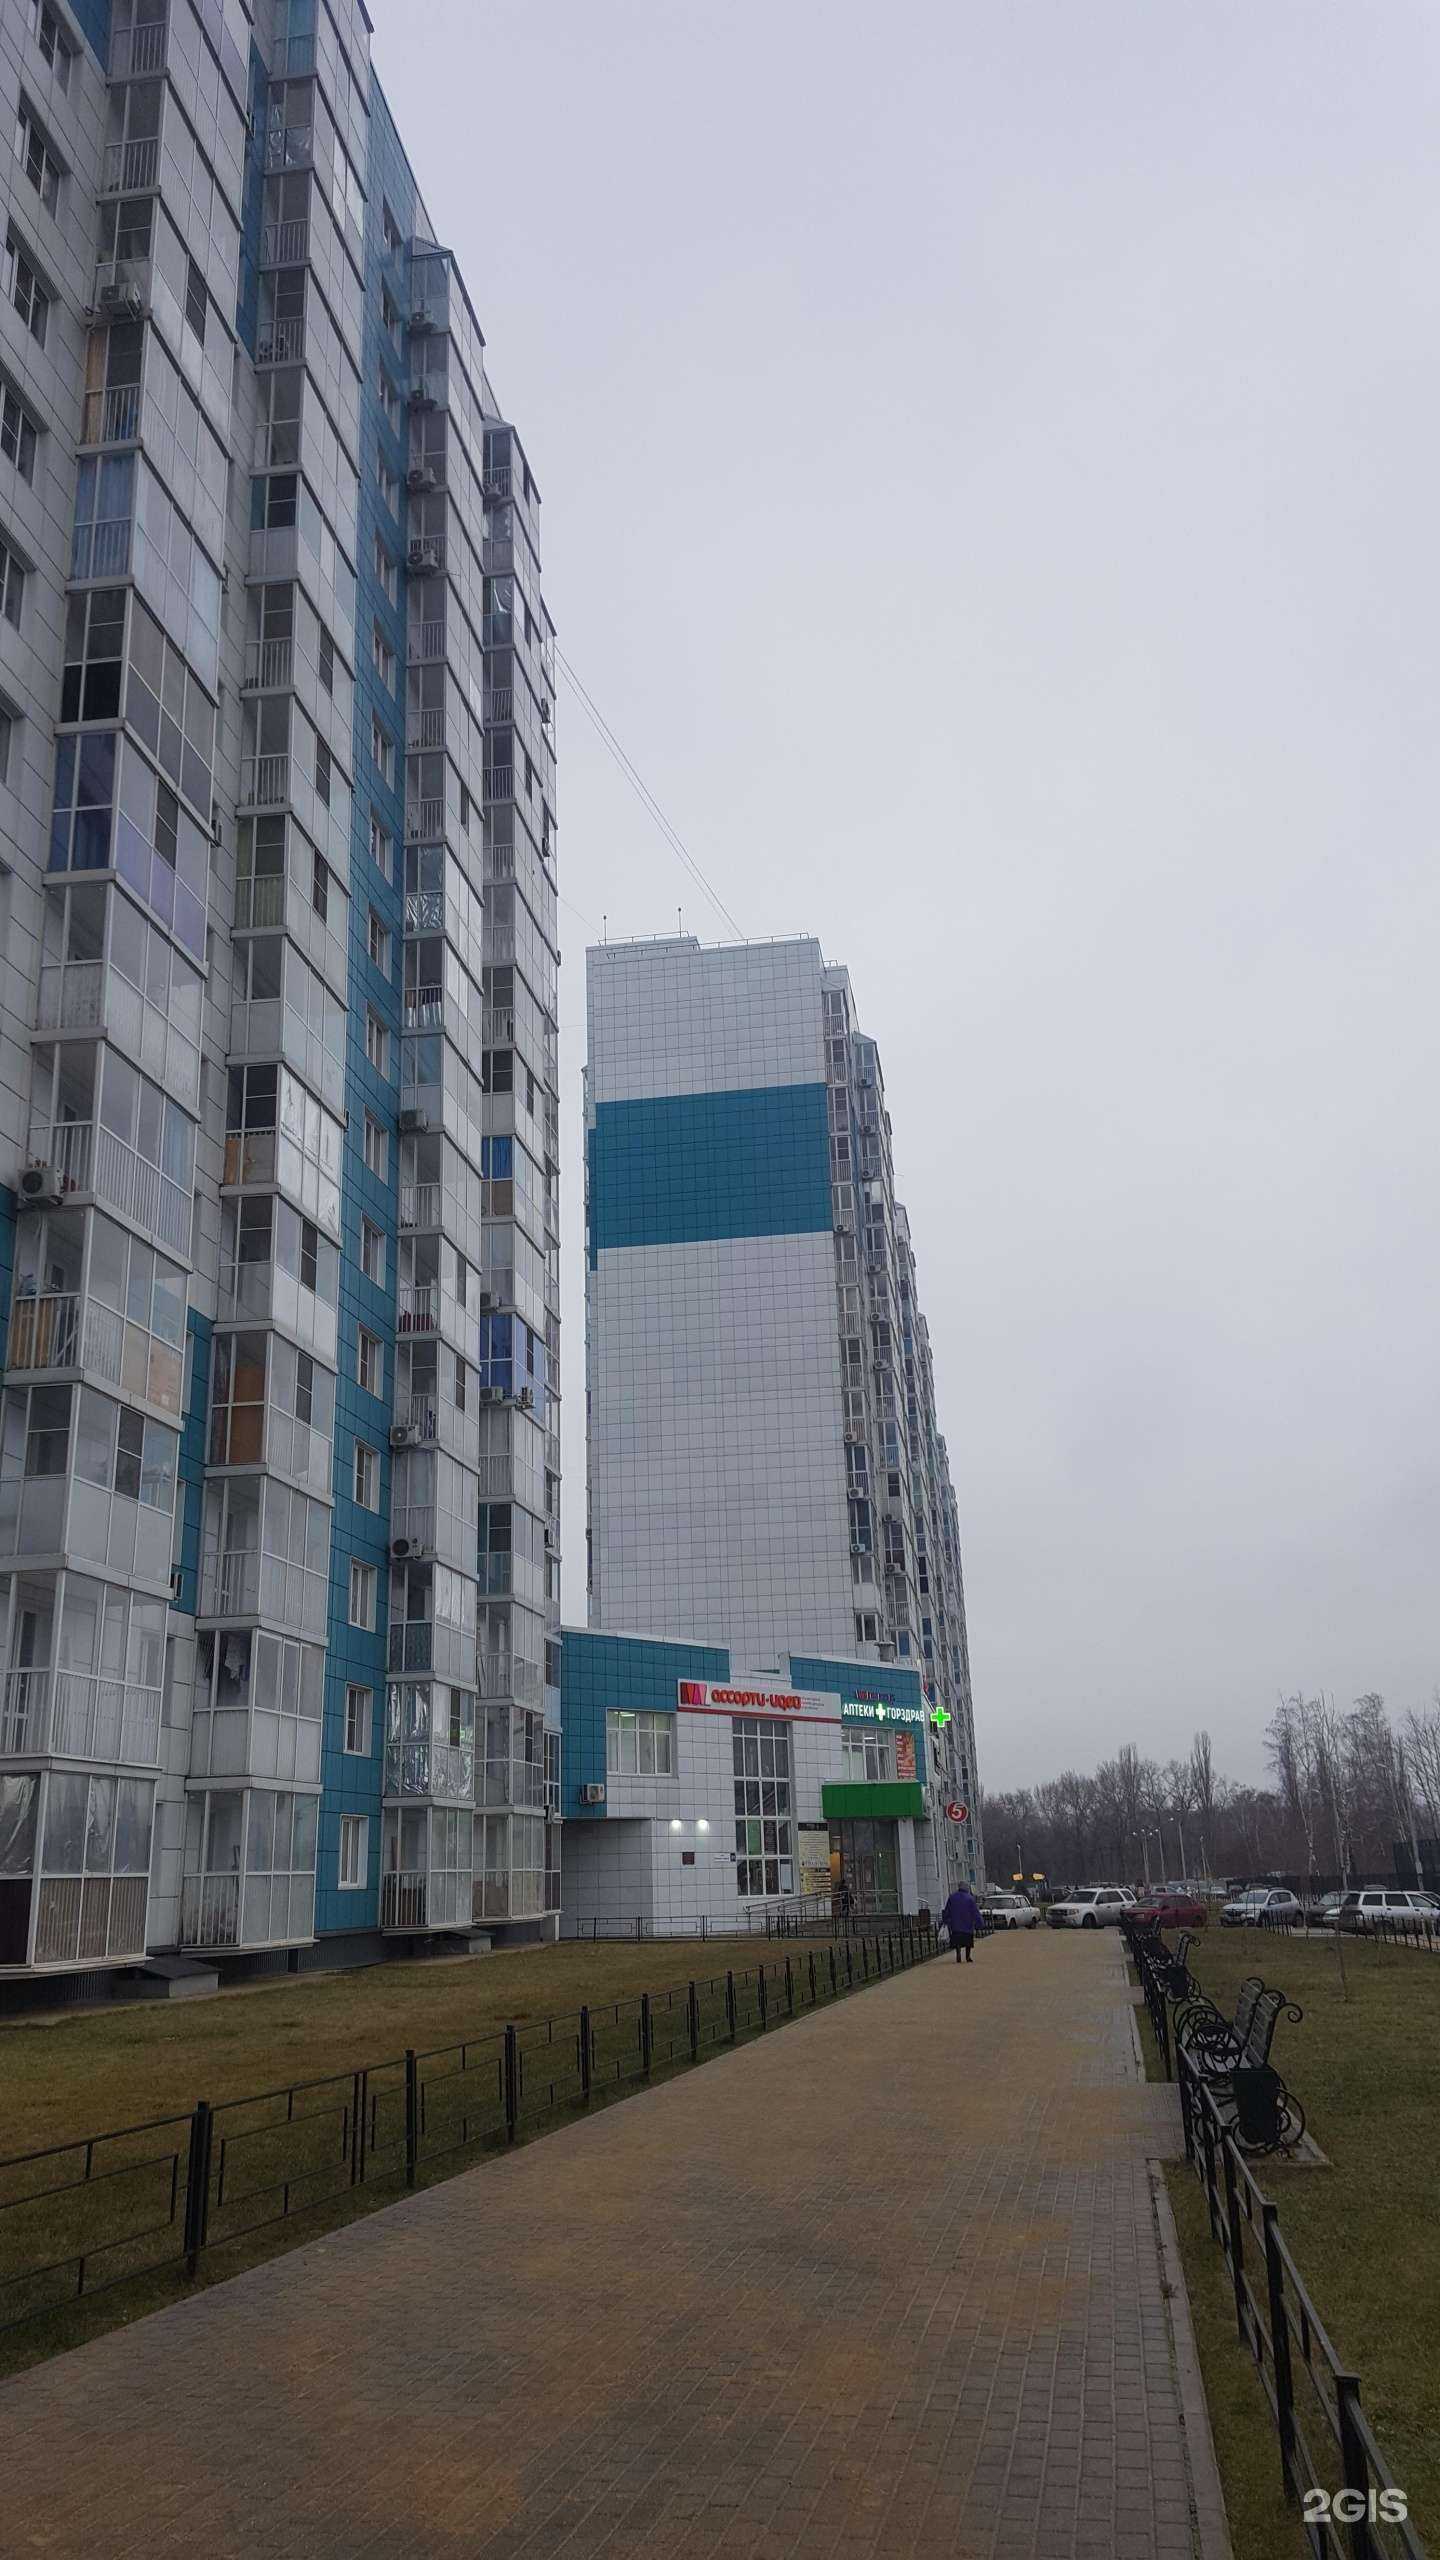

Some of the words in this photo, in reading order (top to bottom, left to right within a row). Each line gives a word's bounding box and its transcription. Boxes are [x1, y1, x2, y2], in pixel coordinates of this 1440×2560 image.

[843, 1703, 875, 1718] АПТЕКИ
[886, 1706, 925, 1723] ГОРЗДРАВ
[951, 1803, 965, 1819] 5
